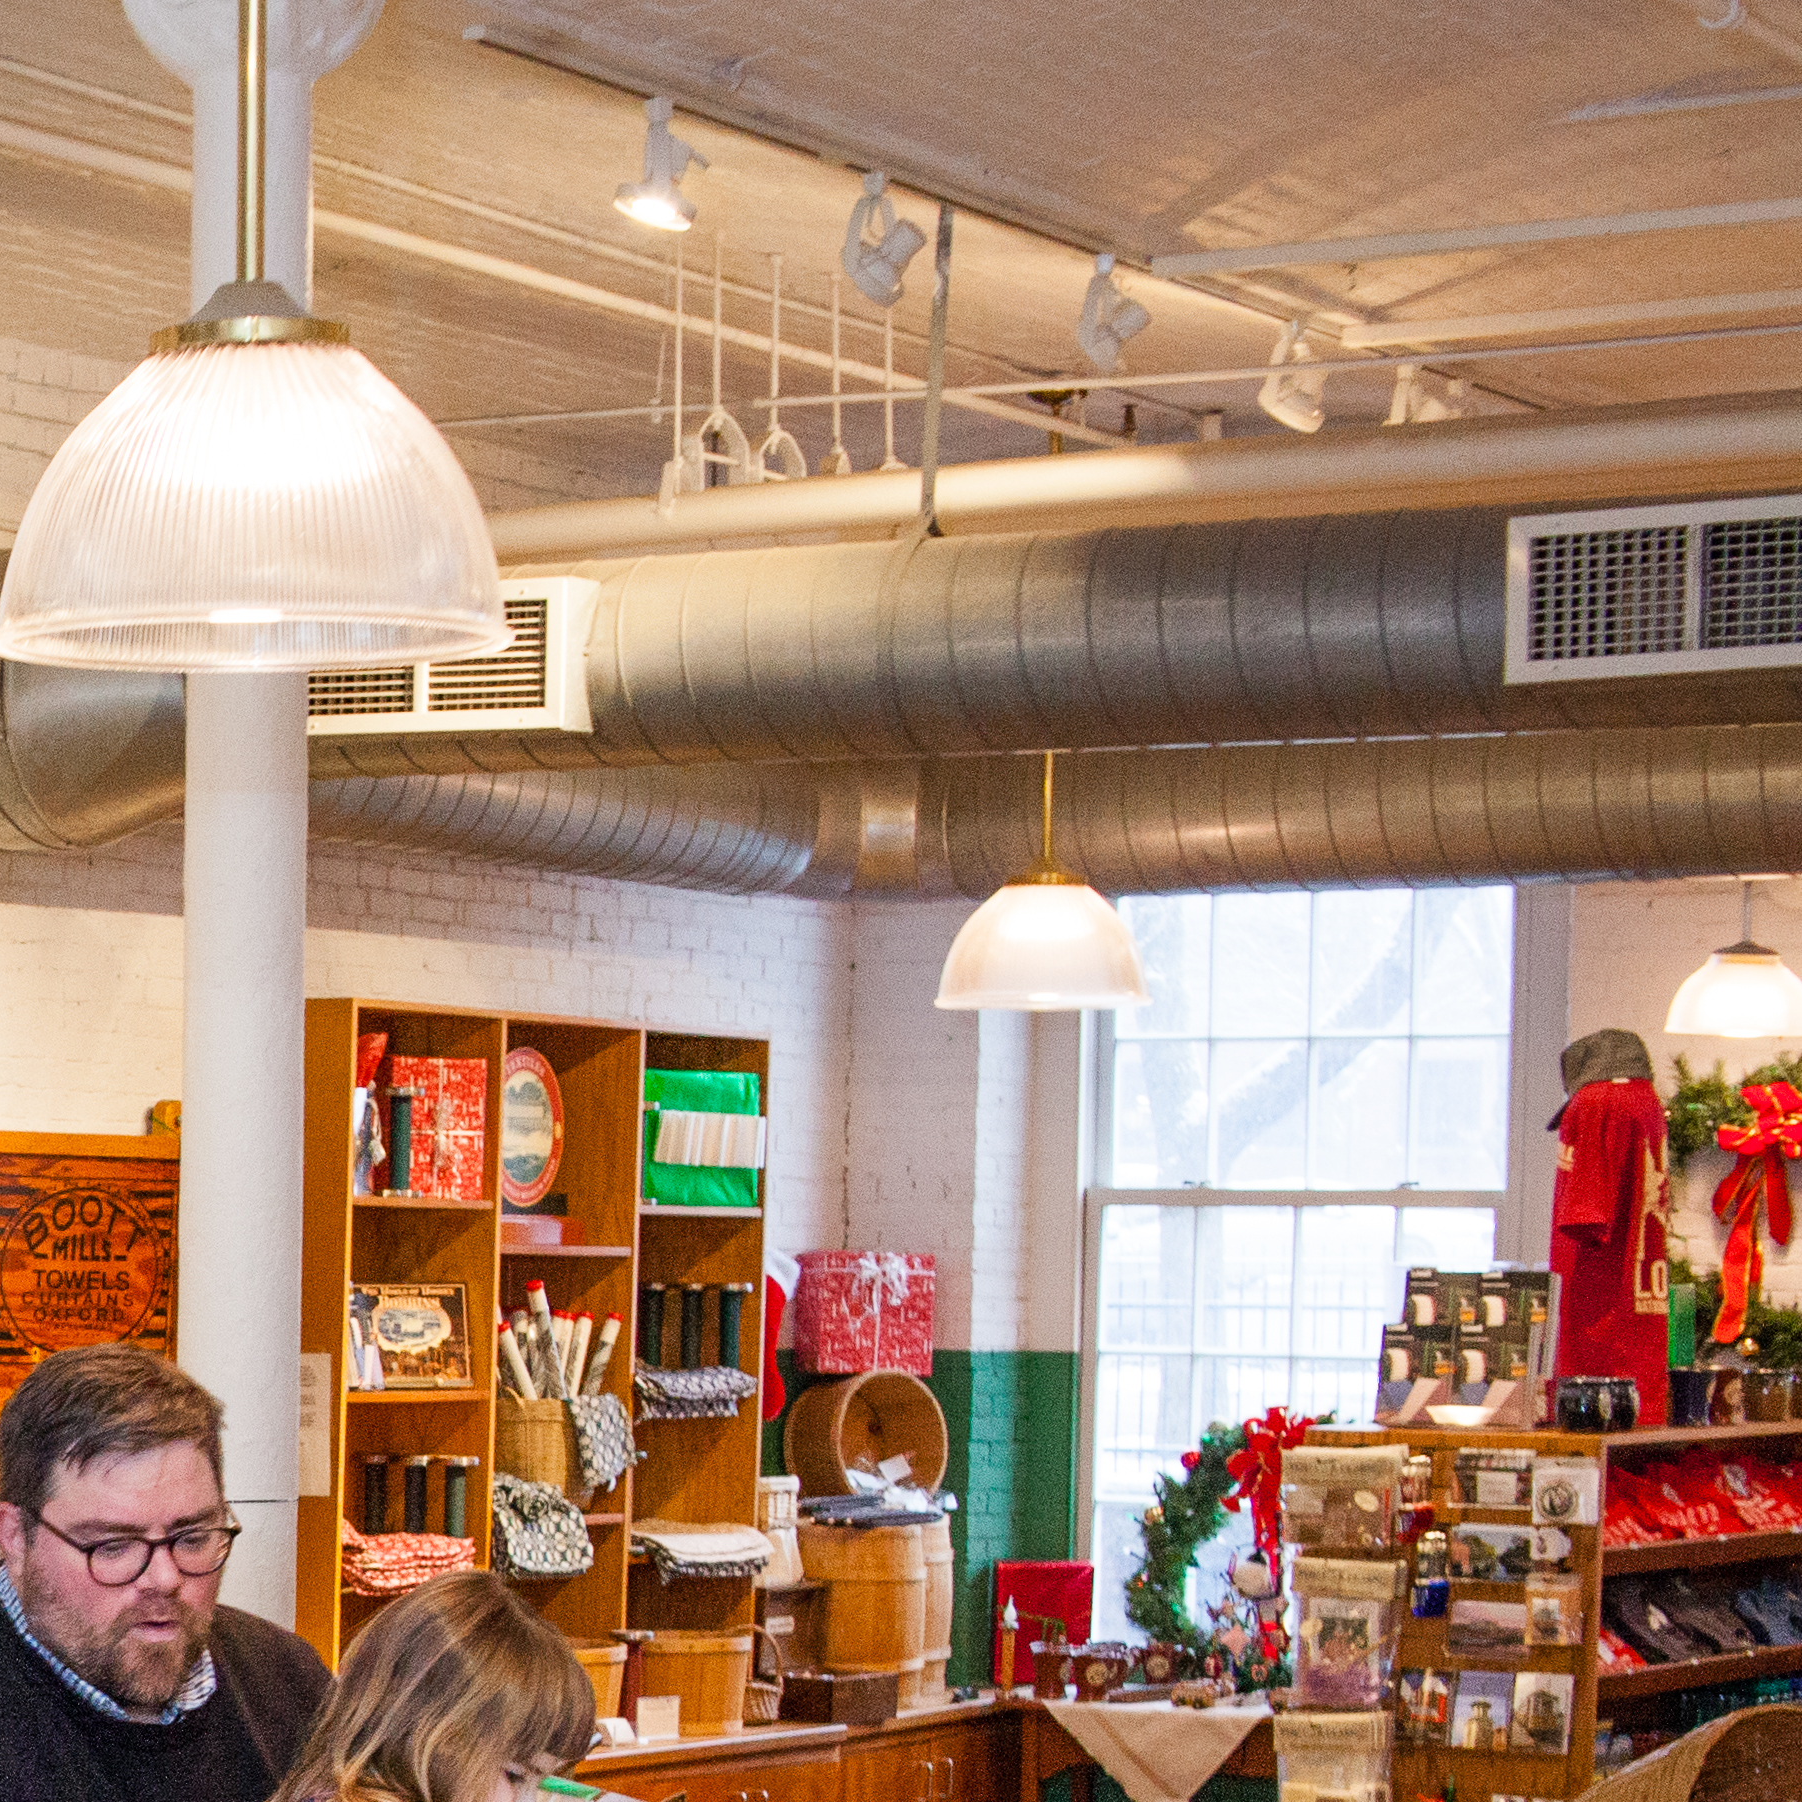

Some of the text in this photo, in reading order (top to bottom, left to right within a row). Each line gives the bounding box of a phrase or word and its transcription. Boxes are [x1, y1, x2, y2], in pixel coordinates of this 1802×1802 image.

[23, 1195, 146, 1251] BOOTT
[33, 1269, 130, 1291] TOWELS
[22, 1291, 134, 1307] CURTAINS
[33, 1308, 125, 1322] OXFORD
